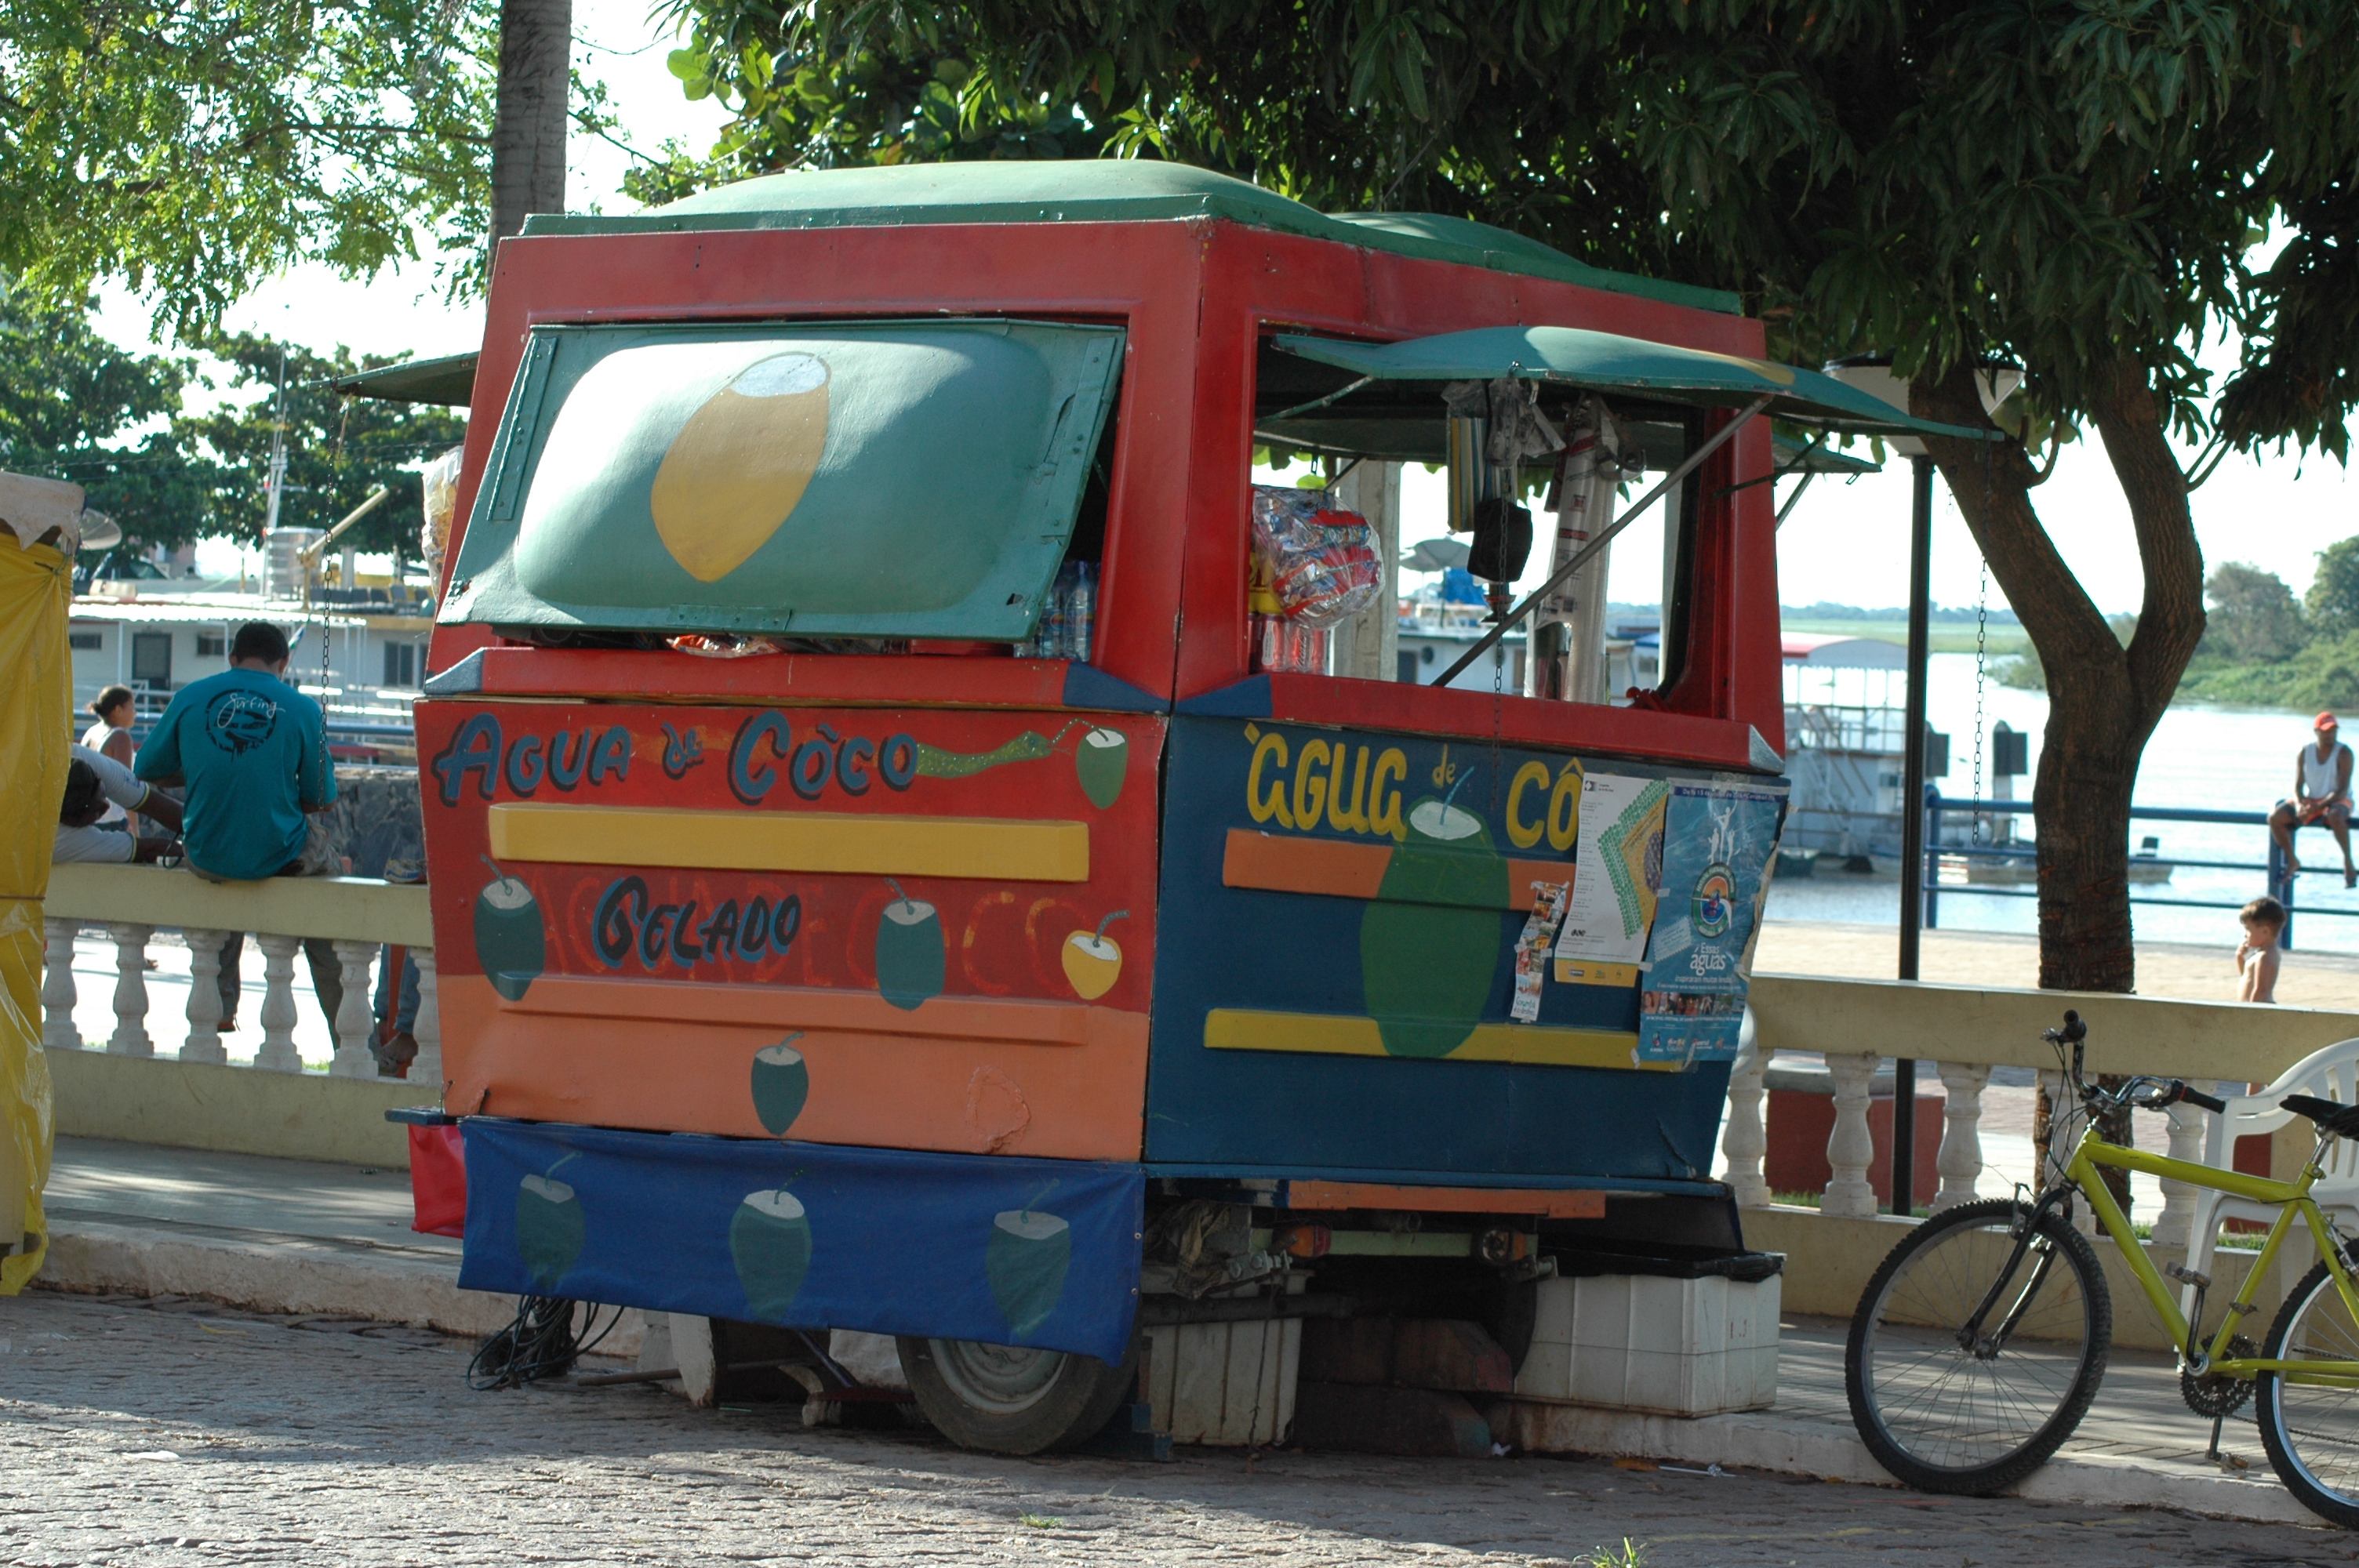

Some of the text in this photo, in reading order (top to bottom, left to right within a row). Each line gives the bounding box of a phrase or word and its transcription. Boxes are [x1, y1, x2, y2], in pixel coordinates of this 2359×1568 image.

[217, 693, 285, 728] Surfing
[660, 721, 705, 780] de
[1432, 743, 1457, 789] de
[1506, 757, 1584, 851] CÔ
[592, 876, 801, 969] GELADO
[1689, 946, 1726, 976] águas
[1700, 942, 1720, 954] Essas
